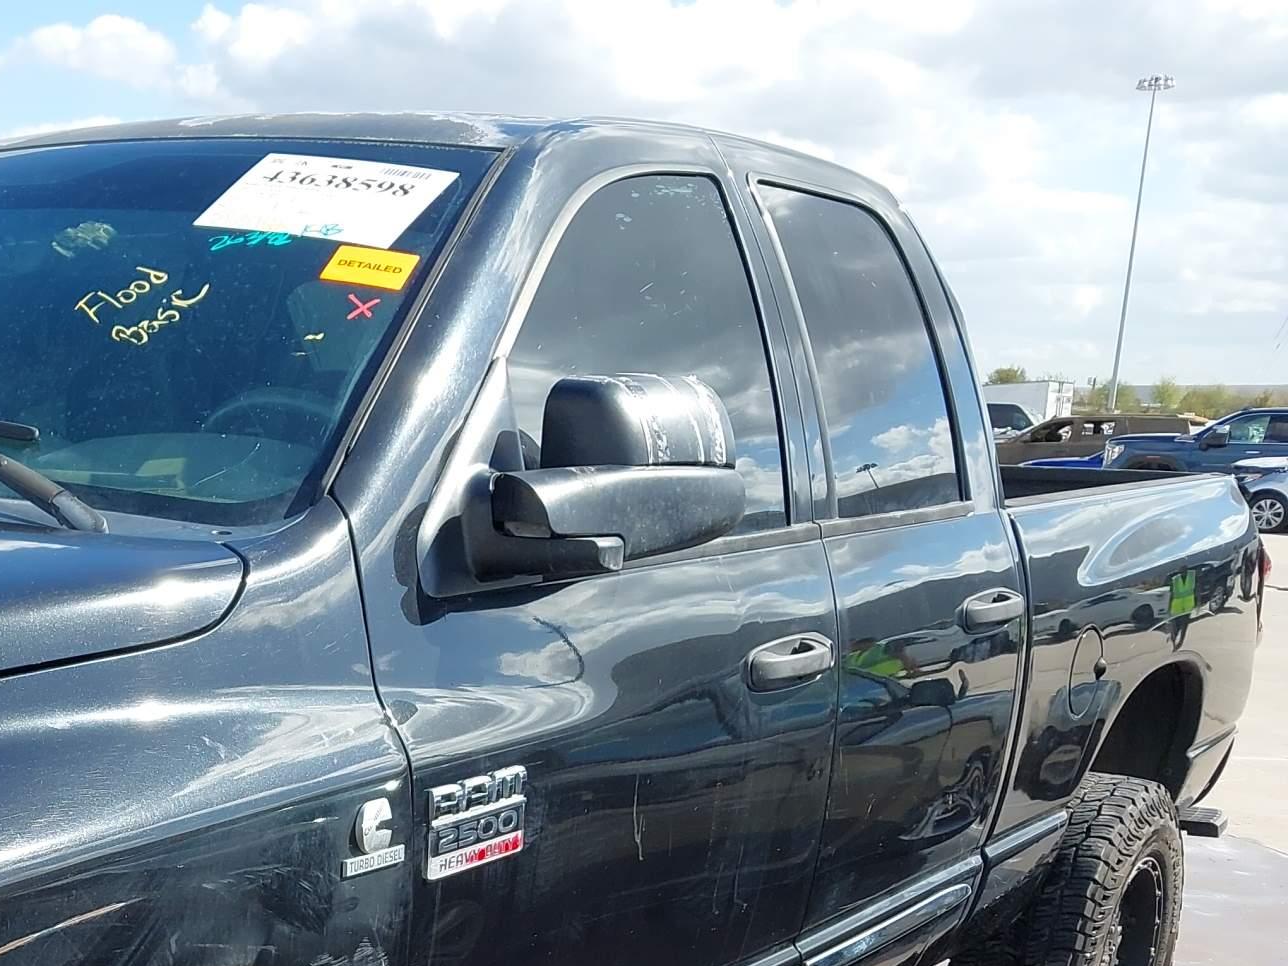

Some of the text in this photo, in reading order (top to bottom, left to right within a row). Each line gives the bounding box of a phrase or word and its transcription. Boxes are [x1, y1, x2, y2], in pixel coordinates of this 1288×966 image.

[263, 169, 416, 197] 43638598
[338, 258, 403, 274] DETAILED
[74, 266, 168, 324] Flood
[112, 282, 210, 345] Basic
[425, 764, 528, 821] RAM
[438, 809, 518, 855] 2500
[349, 847, 403, 872] TURBO DIESEL
[439, 834, 520, 873] HEAVY DUTY
